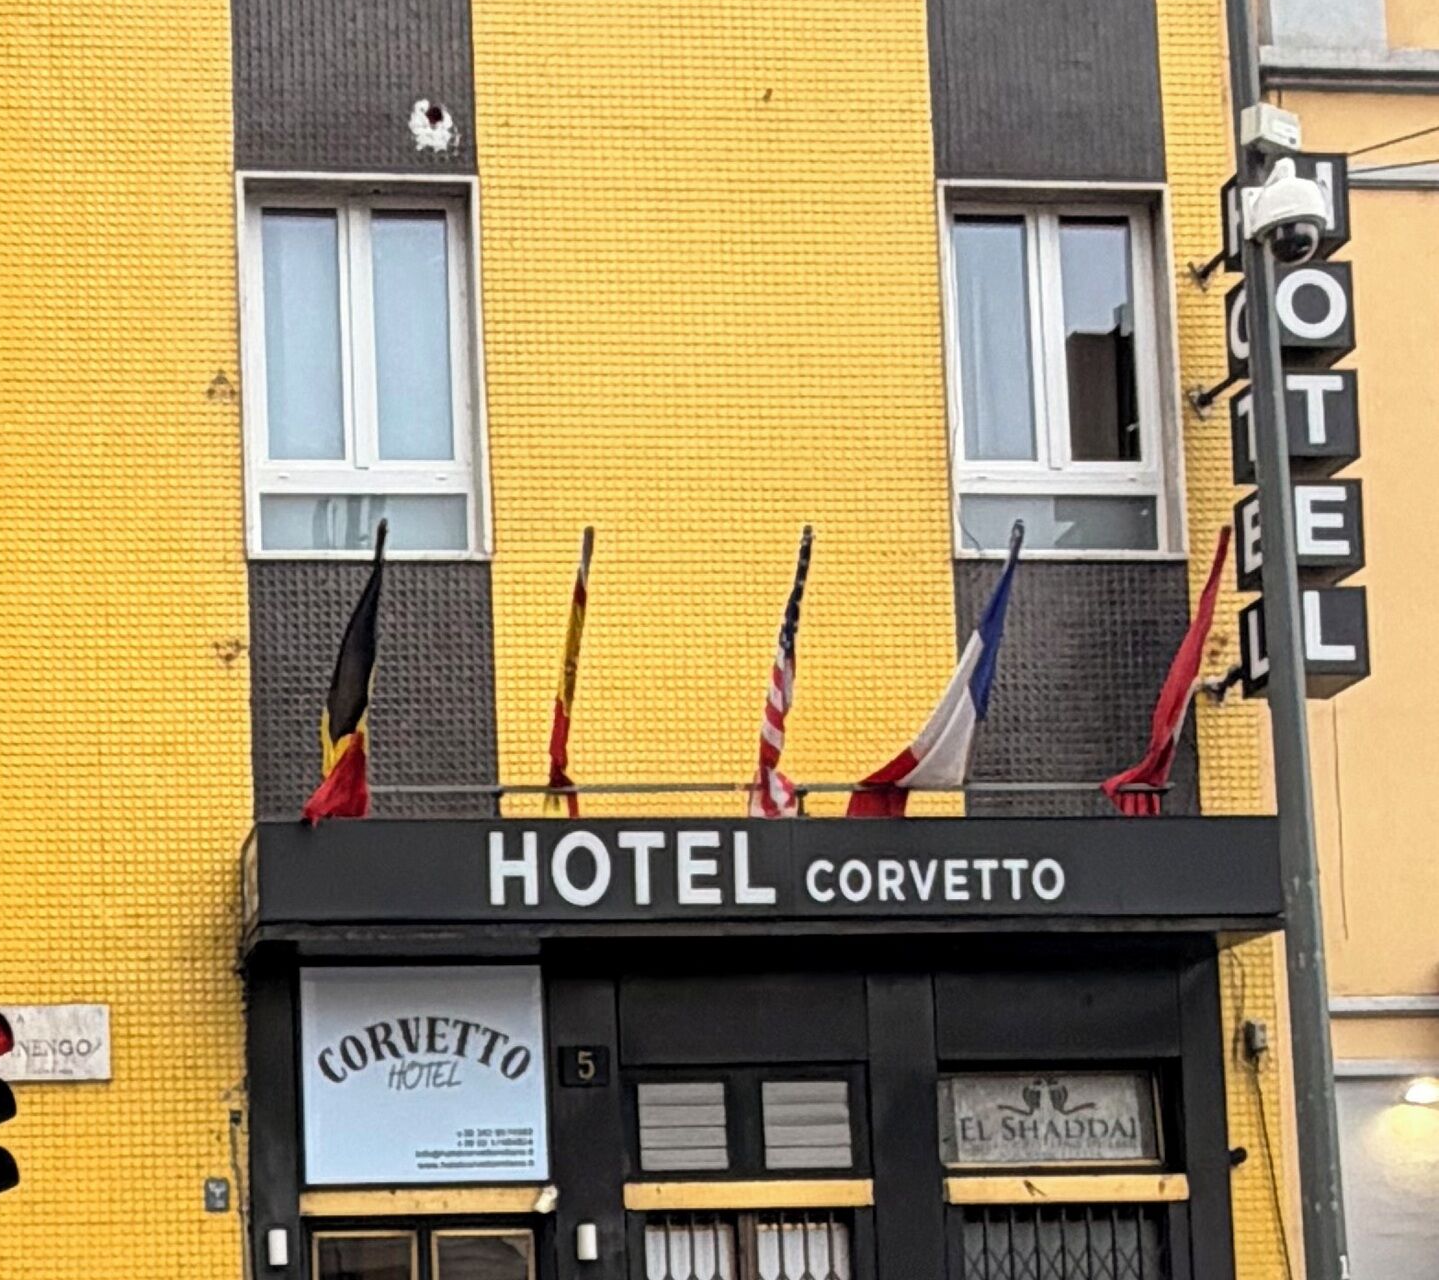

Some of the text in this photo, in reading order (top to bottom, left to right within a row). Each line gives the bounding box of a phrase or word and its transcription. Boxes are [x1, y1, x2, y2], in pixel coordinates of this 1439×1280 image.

[488, 830, 1066, 906] HOTEL CORVETTO
[317, 1016, 532, 1085] CORVETTO
[577, 1051, 596, 1081] 5
[386, 1059, 463, 1091] HOTEL
[959, 1117, 992, 1142] EL
